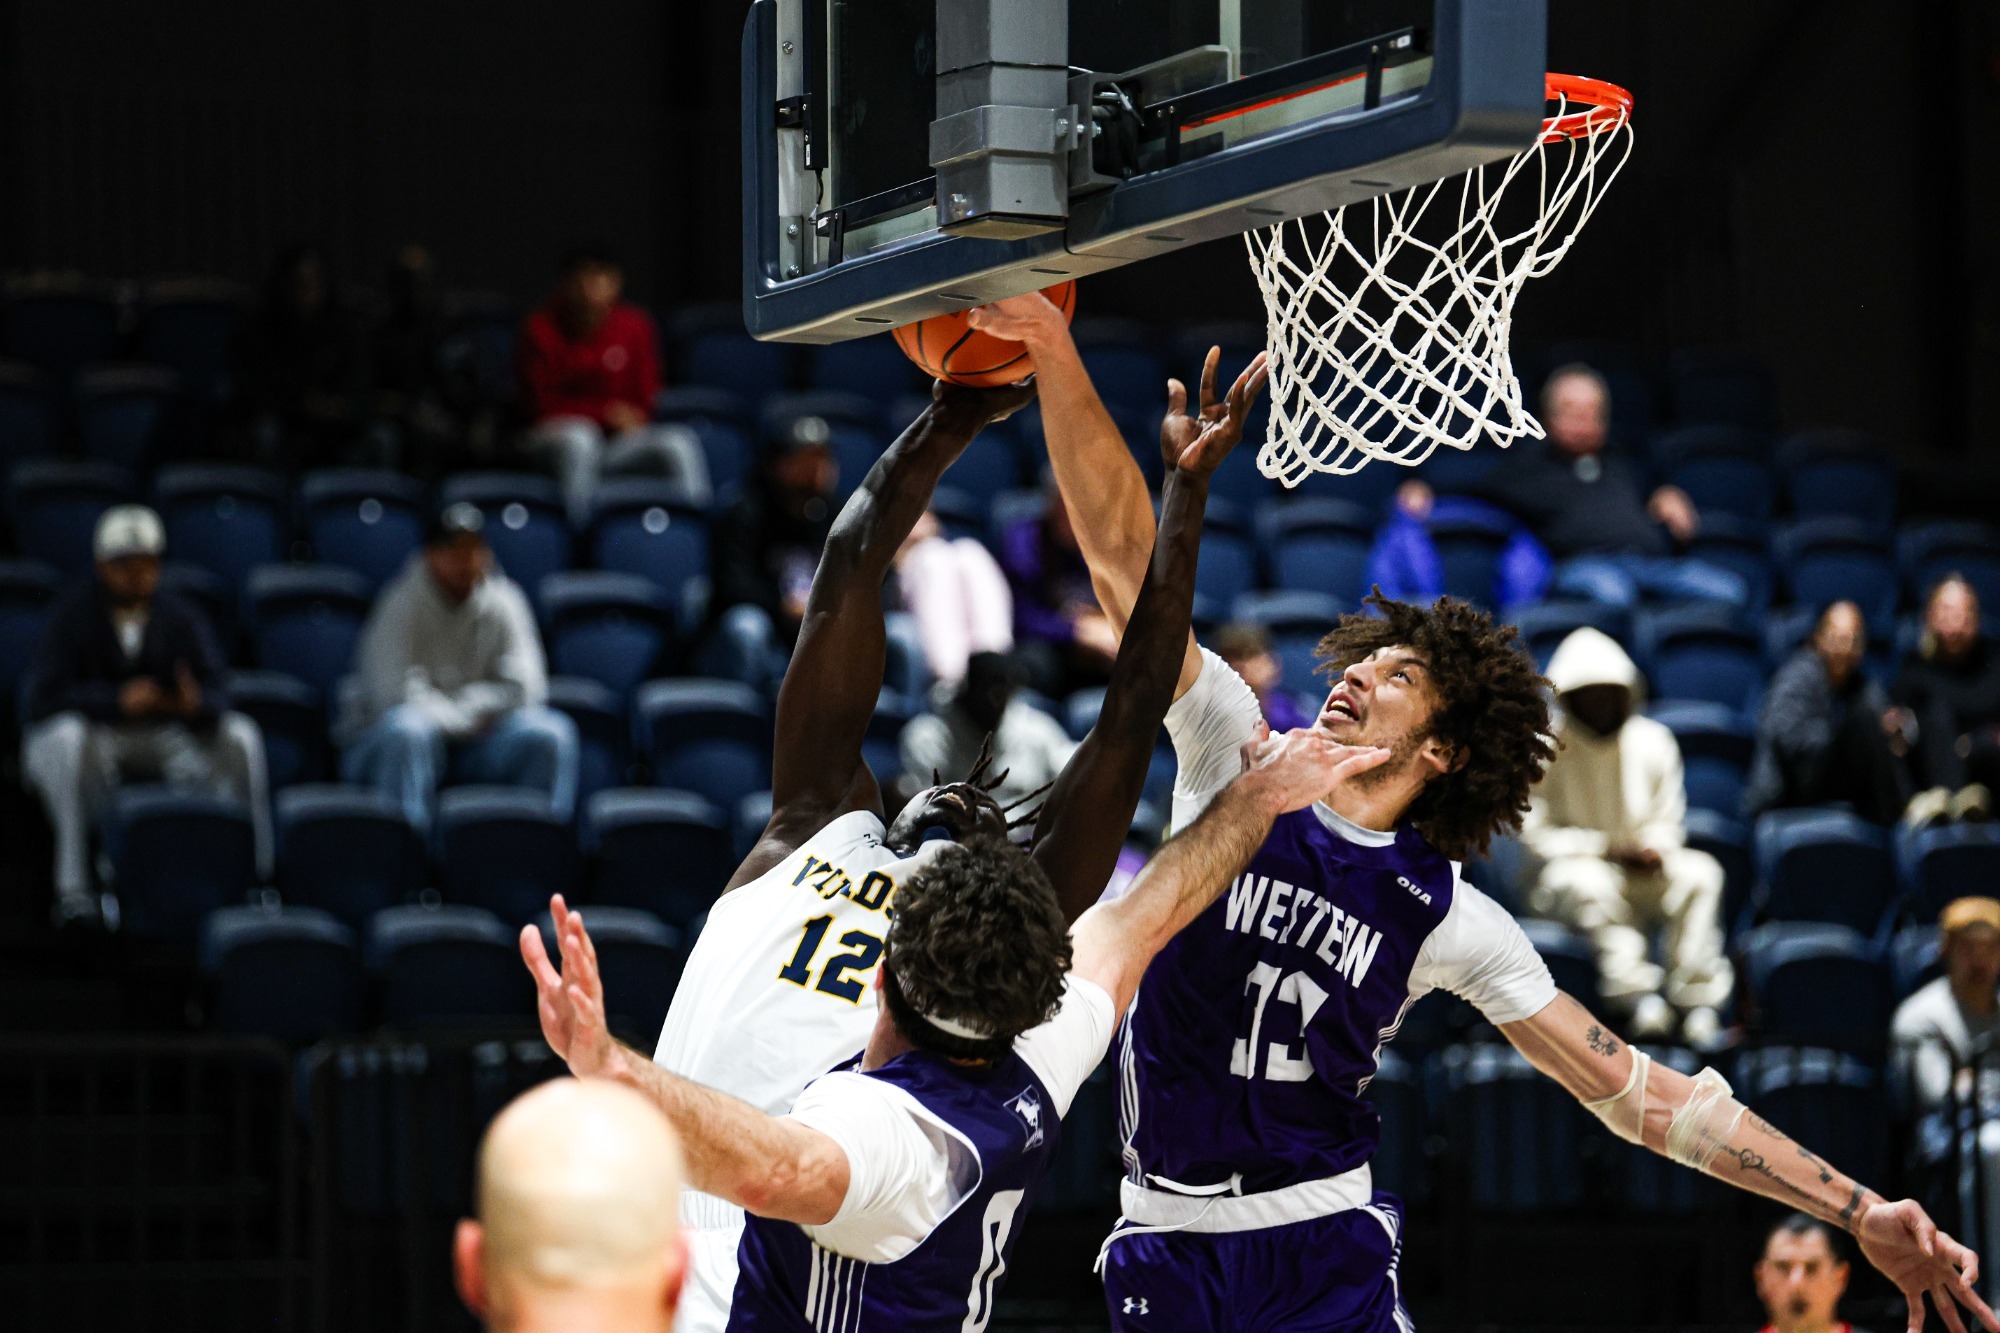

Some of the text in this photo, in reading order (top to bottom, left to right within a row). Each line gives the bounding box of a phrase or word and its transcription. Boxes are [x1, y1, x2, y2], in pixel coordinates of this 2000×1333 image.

[1397, 876, 1432, 906] OUA
[777, 914, 885, 1006] 12
[1229, 960, 1330, 1082] 13
